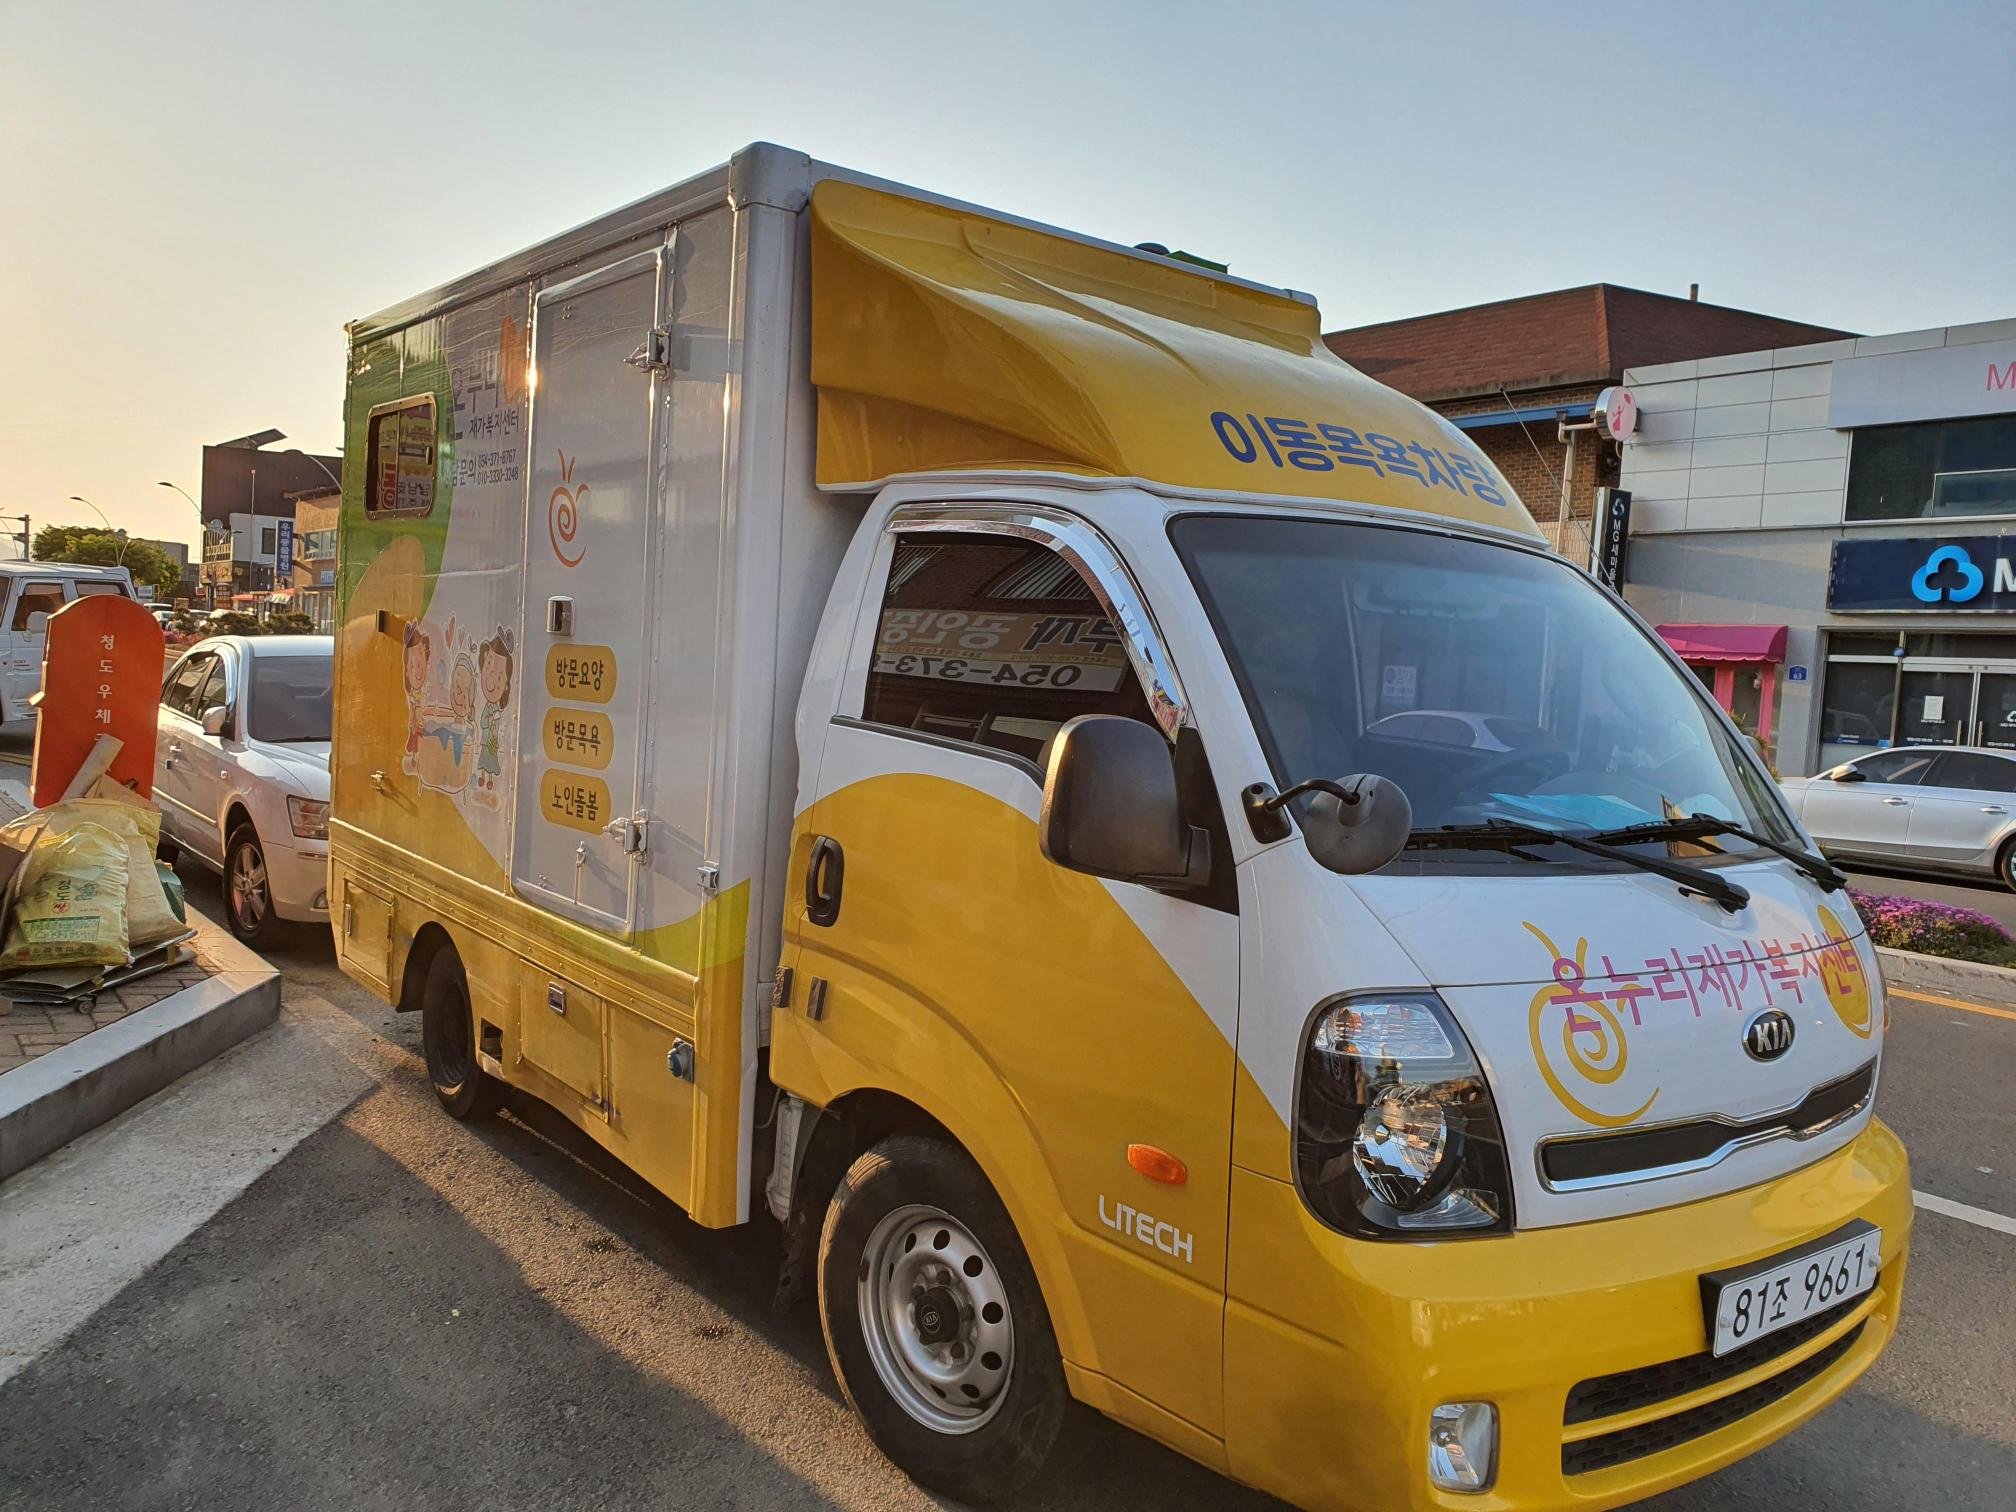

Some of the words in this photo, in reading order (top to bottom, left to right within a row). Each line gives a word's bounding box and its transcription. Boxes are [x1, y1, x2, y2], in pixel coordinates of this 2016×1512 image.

[469, 407, 520, 440] 재가복지센터
[1210, 411, 1507, 507] 이동목욕차량
[556, 657, 604, 692] 방문요양
[554, 719, 601, 757] 방문목욕
[552, 784, 599, 822] 노인돌봄
[1755, 1019, 1792, 1052] KIA
[1099, 1194, 1193, 1264] LITECH
[1732, 1276, 1791, 1338] 81조
[1804, 1243, 1866, 1311] 9661
